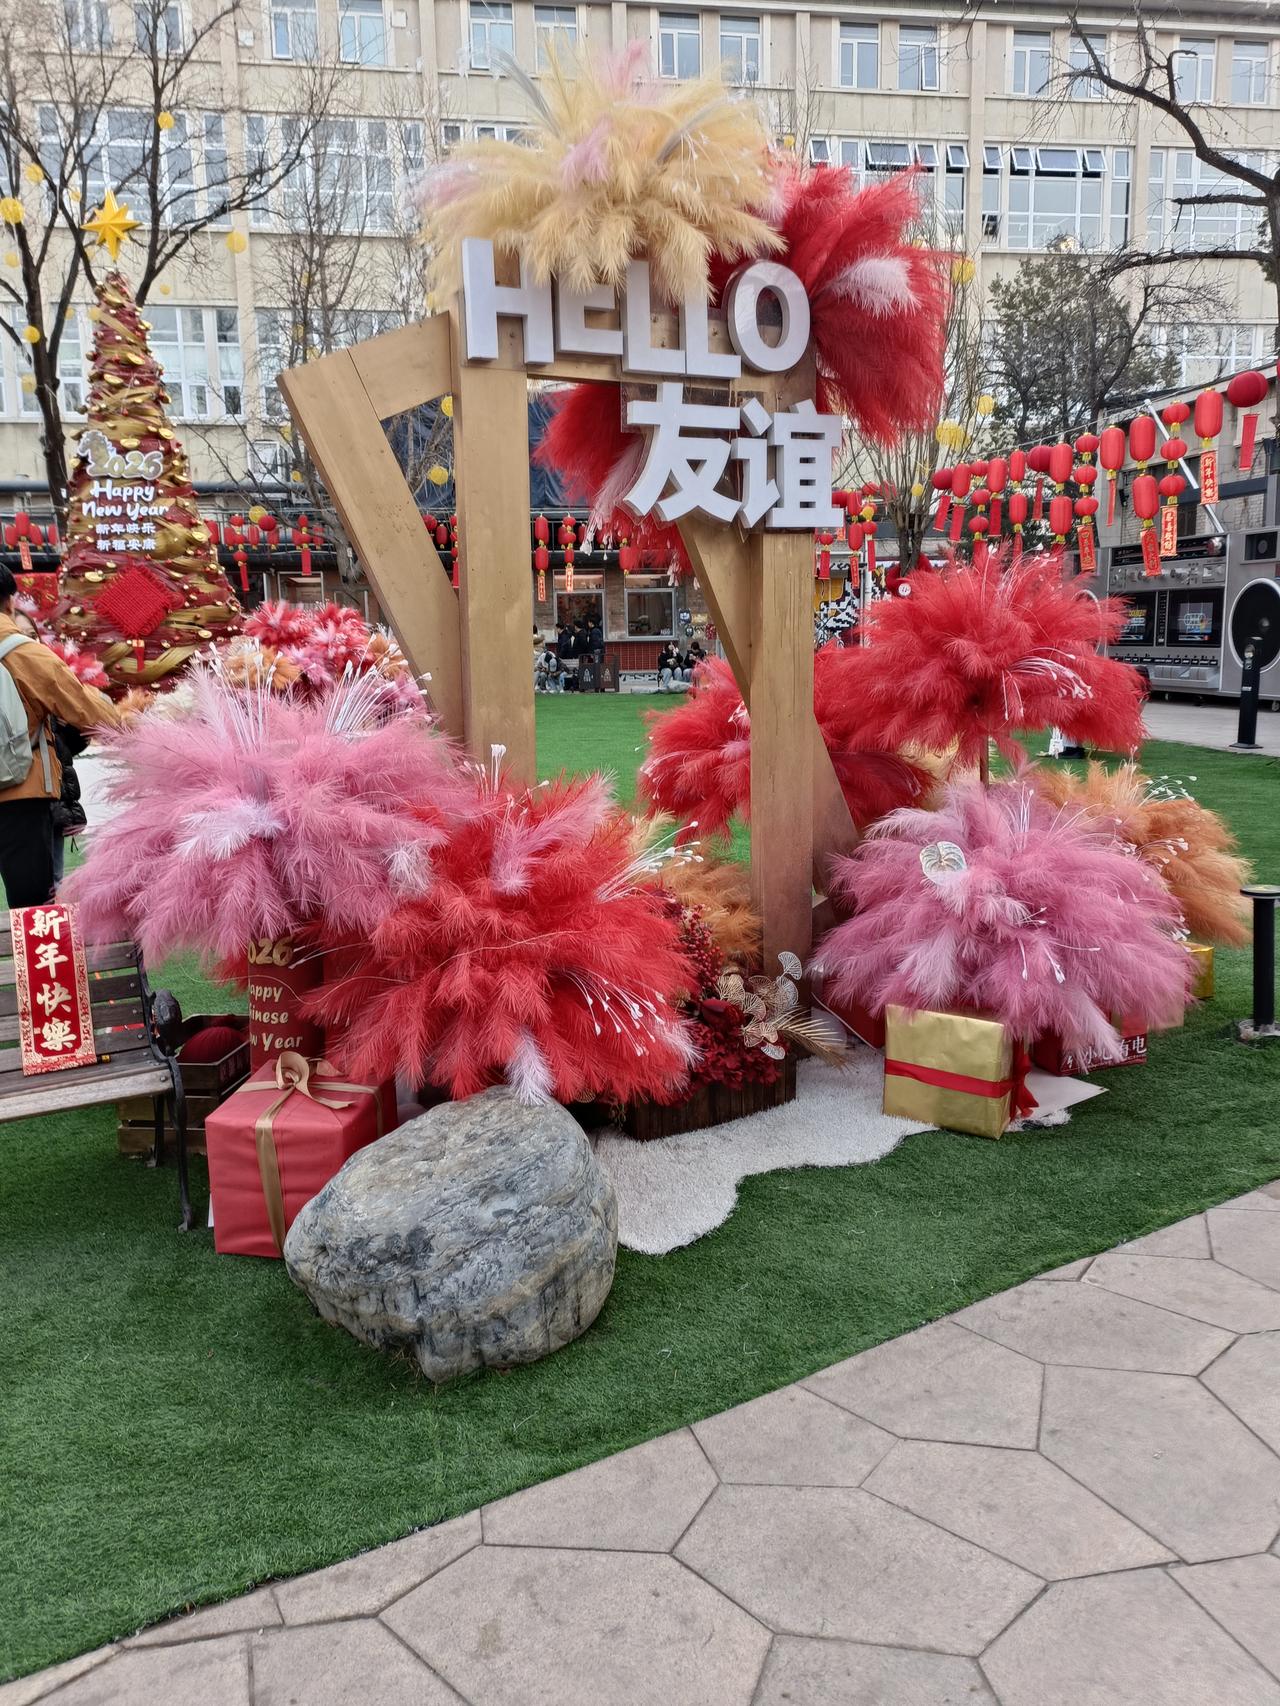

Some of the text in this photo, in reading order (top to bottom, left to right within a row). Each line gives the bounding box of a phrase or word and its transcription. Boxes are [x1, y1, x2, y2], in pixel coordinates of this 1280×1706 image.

[462, 236, 811, 379] HELLO
[79, 433, 163, 480] 2026
[623, 381, 844, 530] 友谊
[91, 480, 154, 501] Happy
[82, 501, 169, 520] New Year
[95, 522, 156, 534] 新年快乐
[29, 909, 77, 1051] 新年快樂
[262, 1032, 303, 1052] Year
